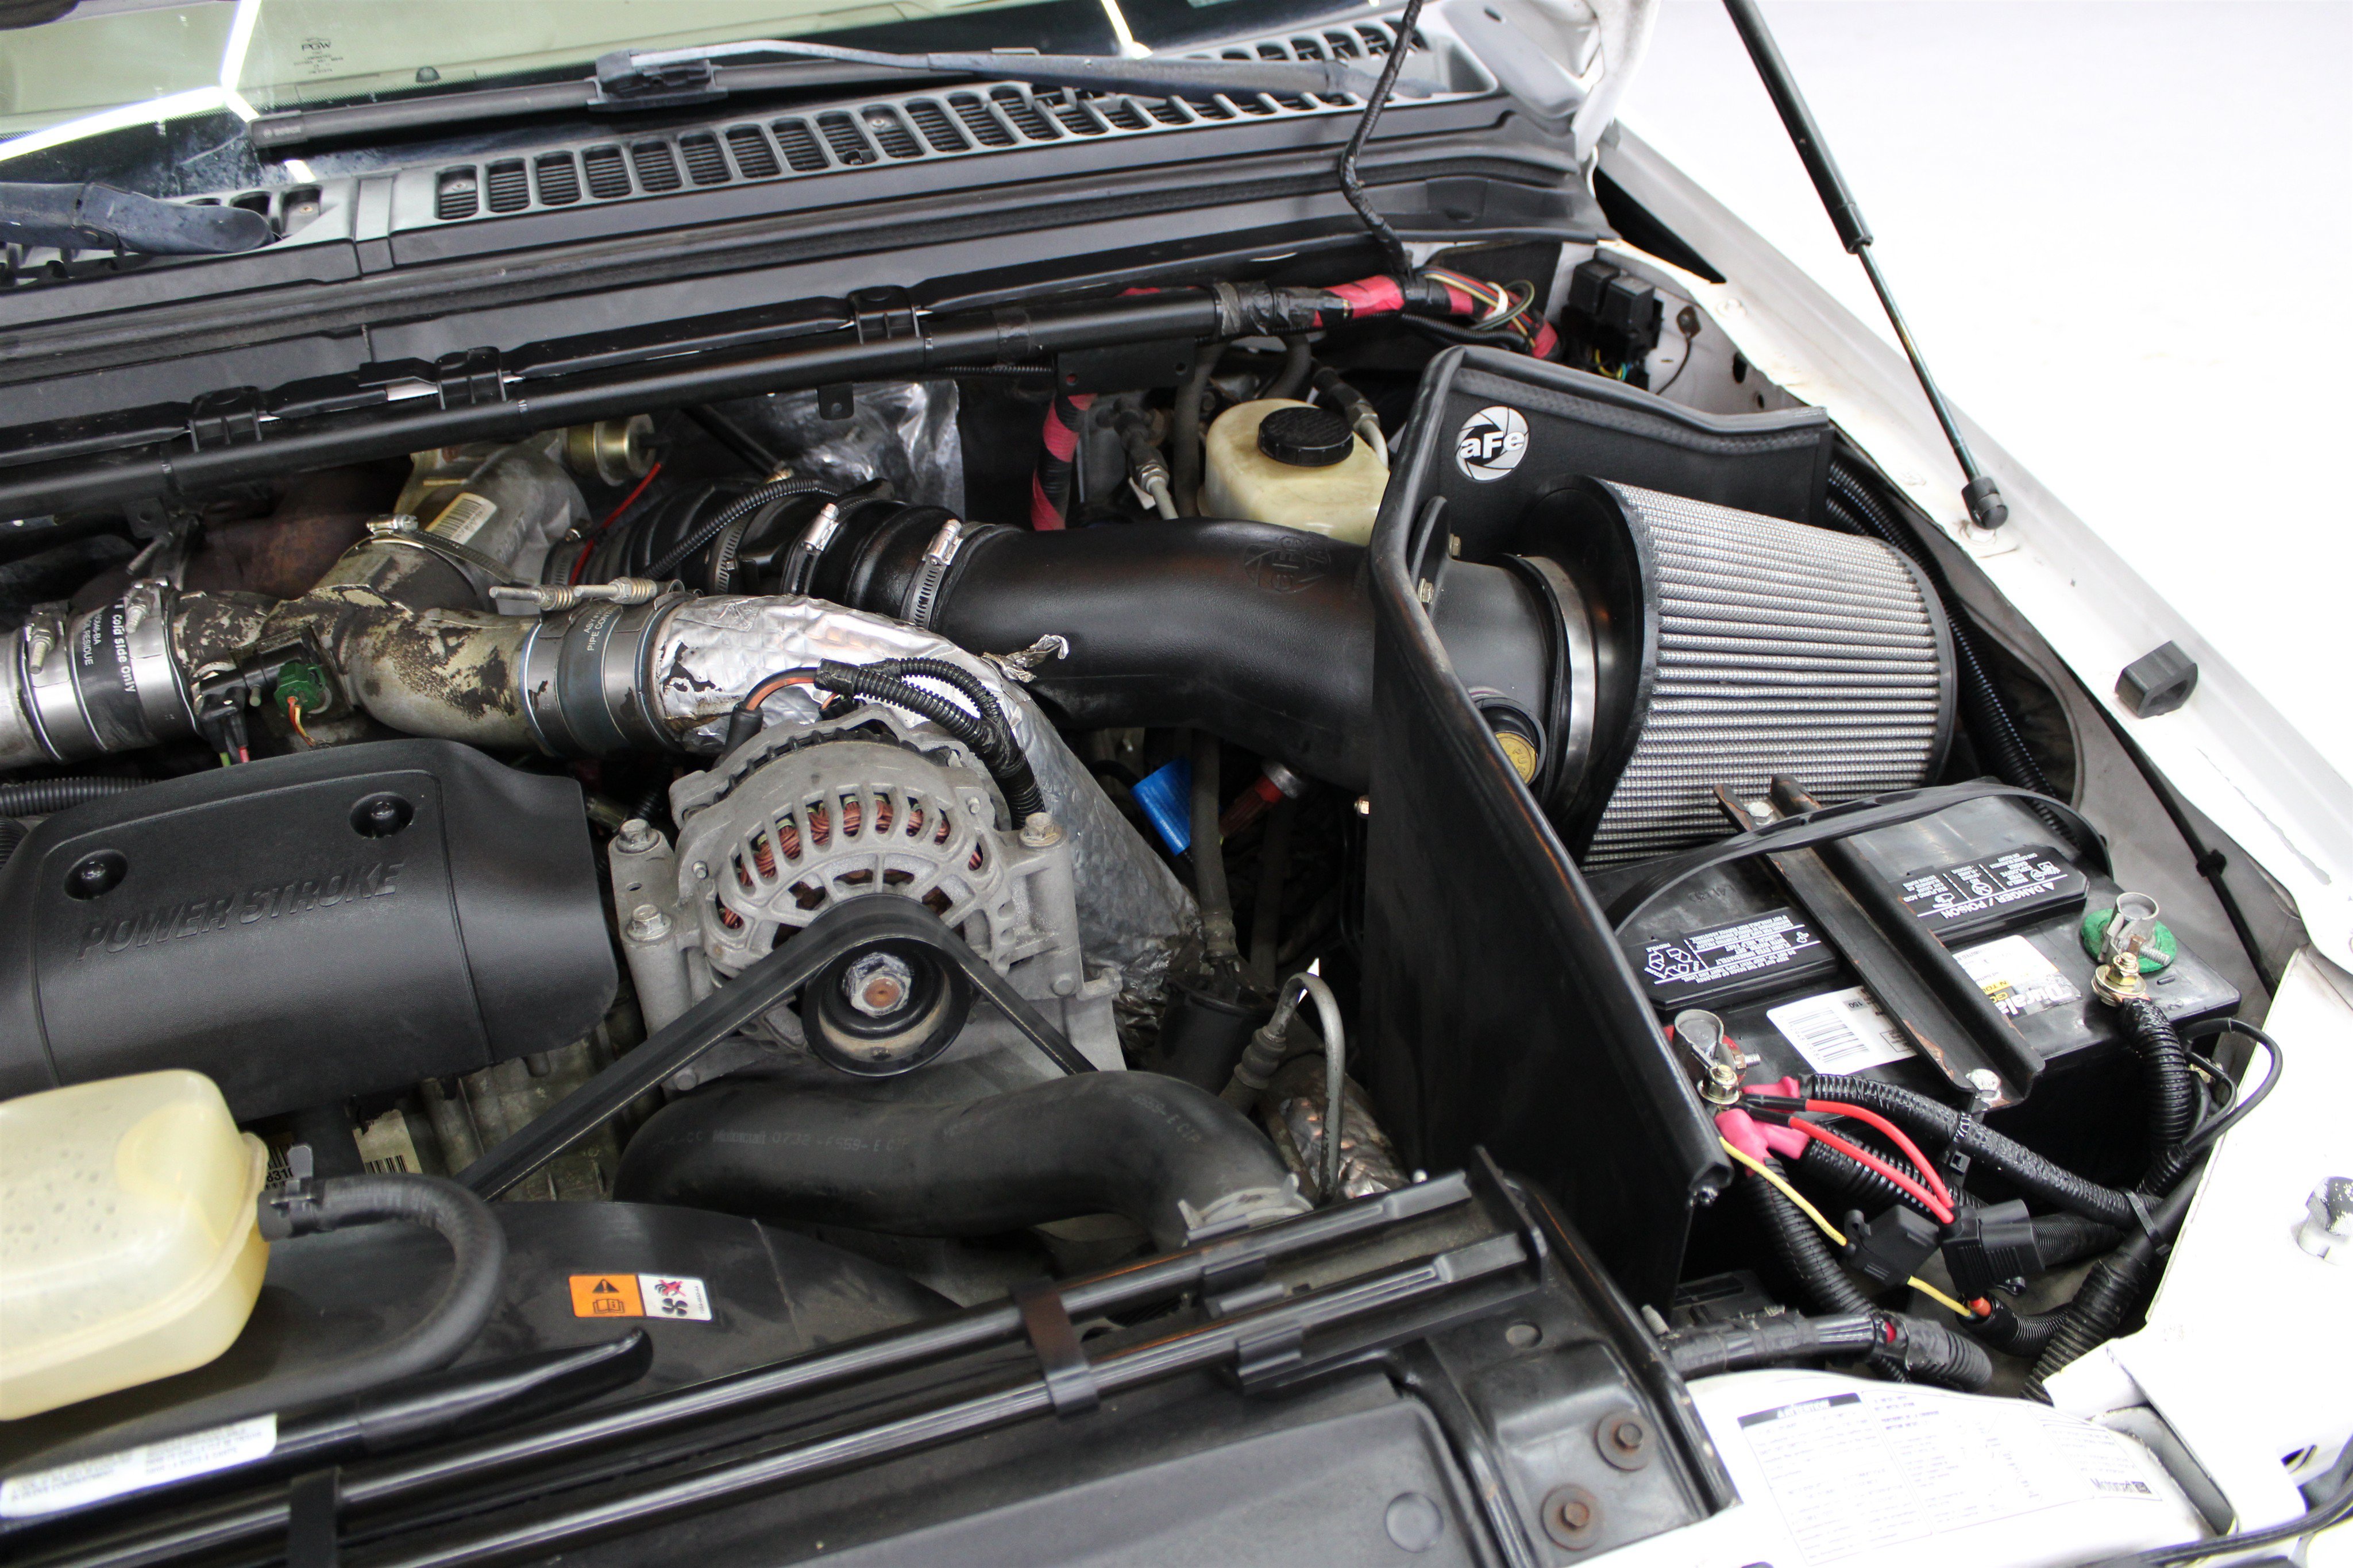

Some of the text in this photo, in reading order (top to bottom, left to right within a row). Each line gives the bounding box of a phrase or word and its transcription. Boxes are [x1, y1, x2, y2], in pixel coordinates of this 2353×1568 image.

[1460, 431, 1525, 459] aFe
[112, 615, 124, 635] cold
[82, 630, 94, 666] RESIDUE
[114, 638, 128, 663] side
[587, 631, 600, 651] PIPE
[121, 666, 136, 692] only
[1513, 748, 1527, 774] PUS
[2000, 864, 2033, 877] EXPLOSIVE
[1917, 886, 1949, 898] SULFURIC
[1994, 883, 2046, 903] DANGER
[77, 863, 403, 960] POWER STROKE
[1939, 899, 1988, 918] POISON
[1645, 943, 1671, 953] RECYCLE
[1715, 941, 1791, 965] FLUSH EYES IMMEDIATELY
[1725, 943, 1741, 951] FAST
[1741, 939, 1757, 948] HELP
[1695, 972, 1722, 983] CHILDREN
[1709, 967, 1726, 975] TIGHT
[1848, 1001, 1864, 1009] 150
